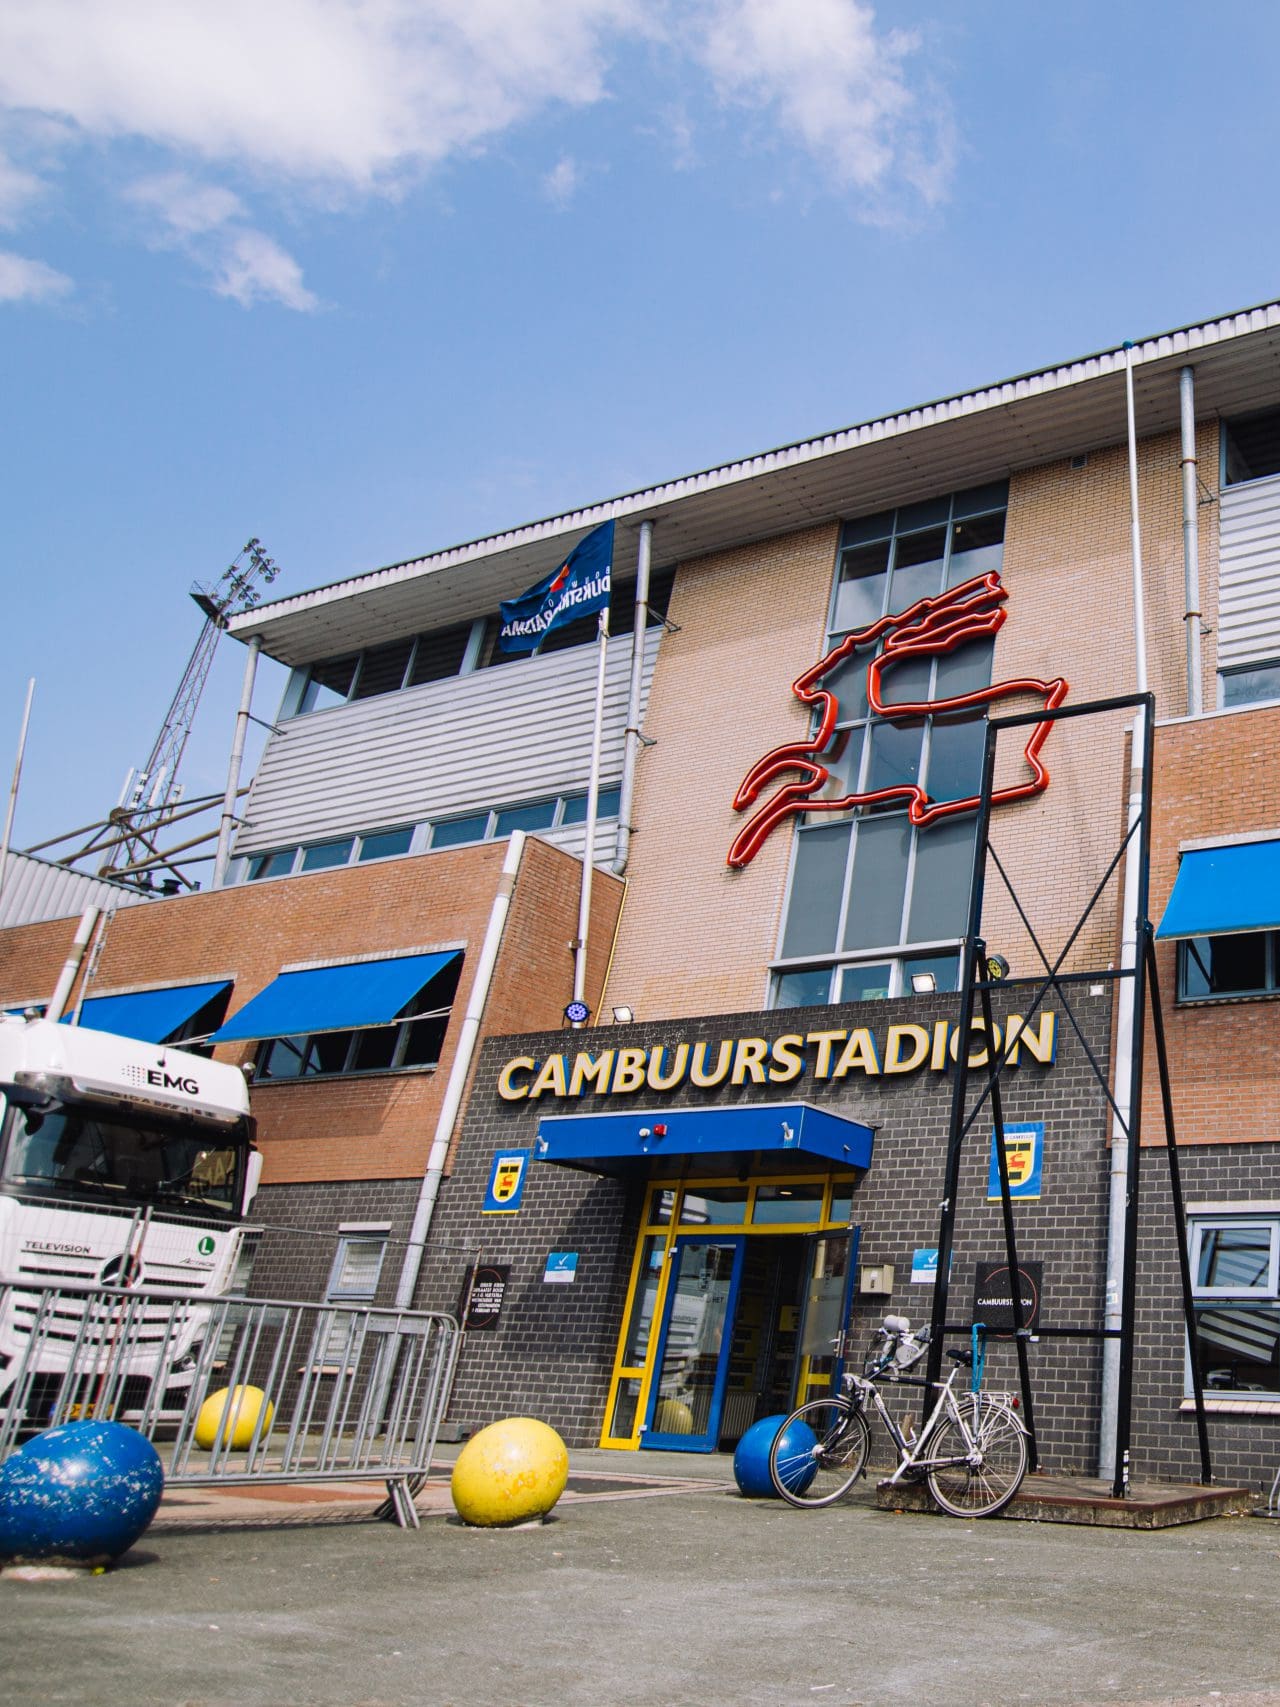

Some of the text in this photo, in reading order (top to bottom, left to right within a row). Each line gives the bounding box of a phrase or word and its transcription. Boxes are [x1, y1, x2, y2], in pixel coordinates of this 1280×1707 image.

[498, 1011, 1057, 1100] CAMBUURSTADION
[147, 1069, 199, 1094] EMG
[25, 1240, 91, 1254] TELEVISION
[201, 1238, 210, 1253] L
[977, 1298, 1033, 1307] CAMBUURSTION
